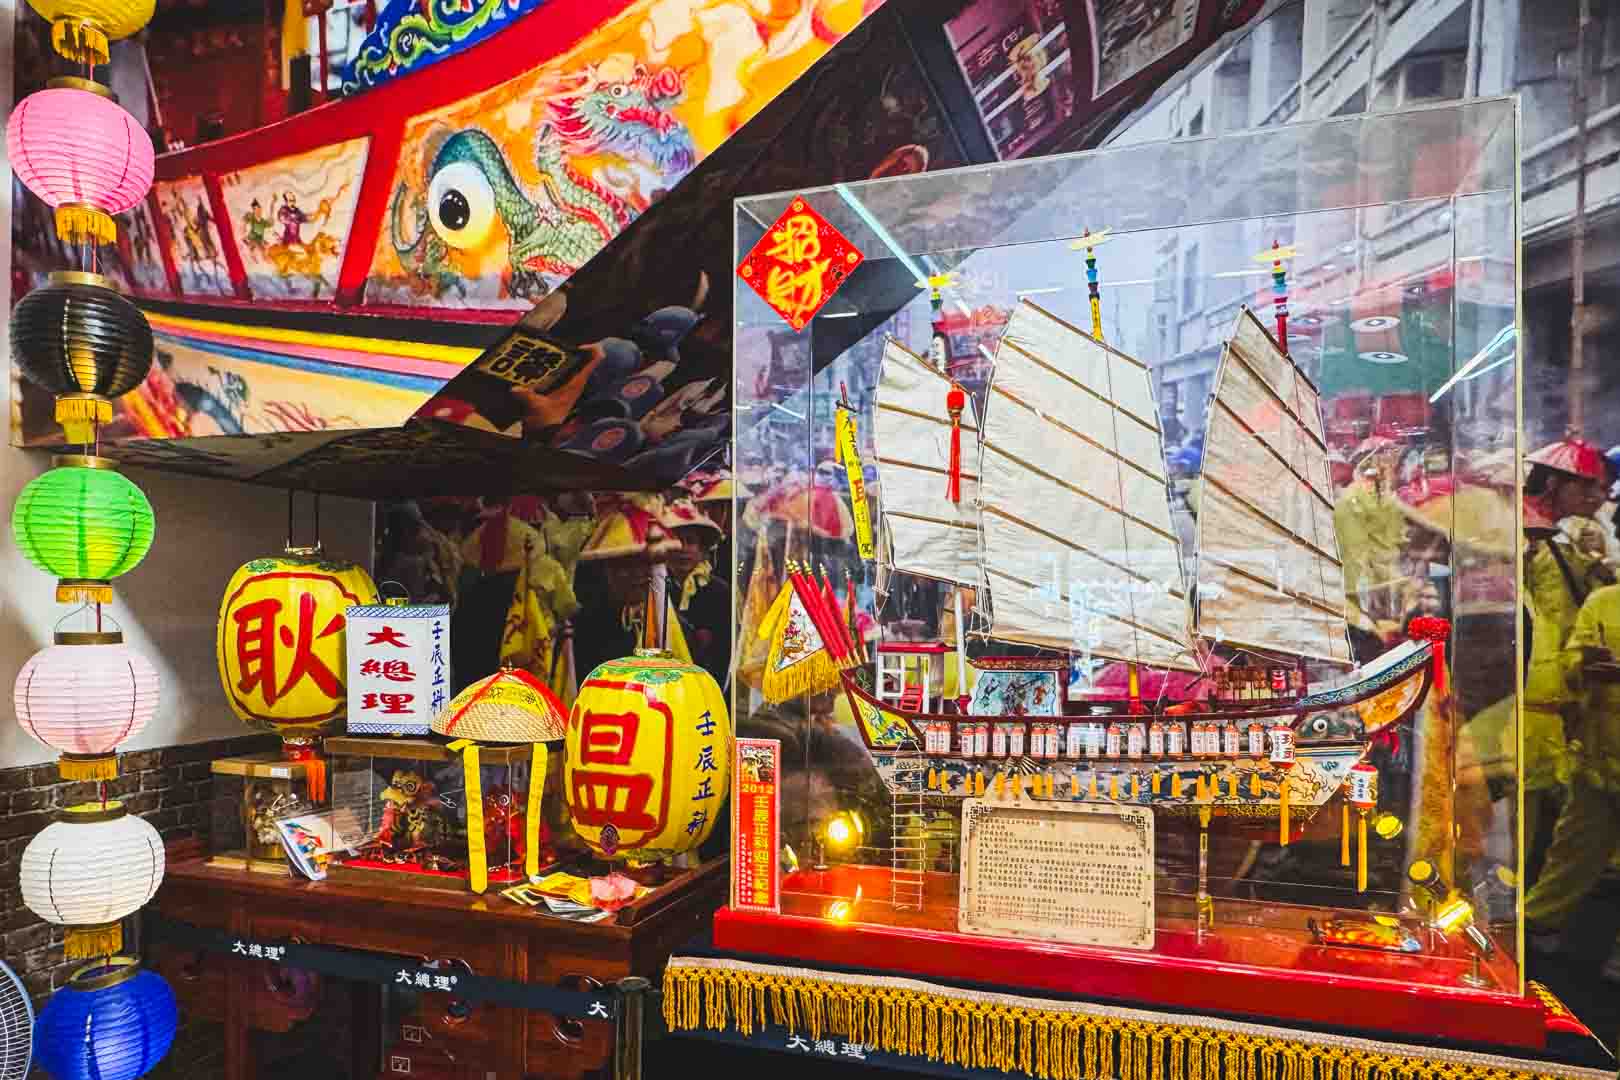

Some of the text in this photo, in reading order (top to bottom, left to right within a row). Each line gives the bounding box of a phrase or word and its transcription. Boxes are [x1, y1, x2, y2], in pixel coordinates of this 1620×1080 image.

[359, 626, 417, 714] 大總理
[685, 710, 718, 836] 壬辰正科
[742, 782, 775, 795] 2012
